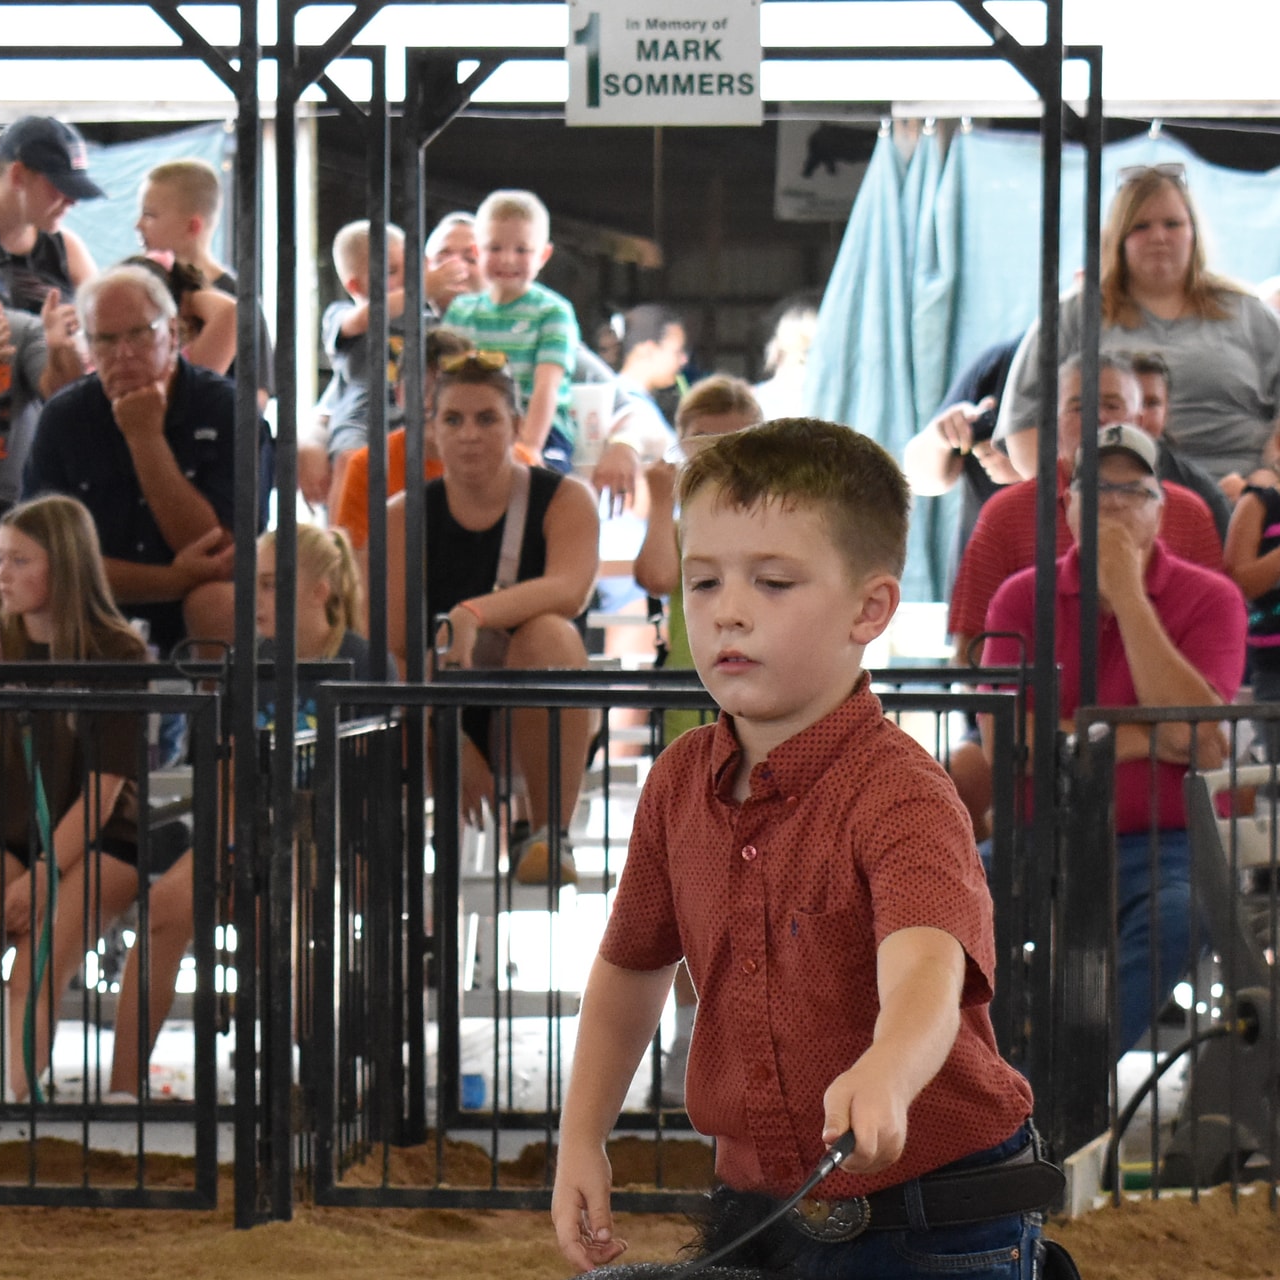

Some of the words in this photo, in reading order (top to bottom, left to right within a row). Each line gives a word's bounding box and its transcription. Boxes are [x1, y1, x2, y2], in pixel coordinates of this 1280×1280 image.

[625, 18, 641, 31] In
[645, 18, 708, 34] Memory
[711, 17, 729, 31] of
[573, 12, 600, 109] 1
[635, 39, 722, 62] MARK
[603, 73, 755, 97] SOMMERS
